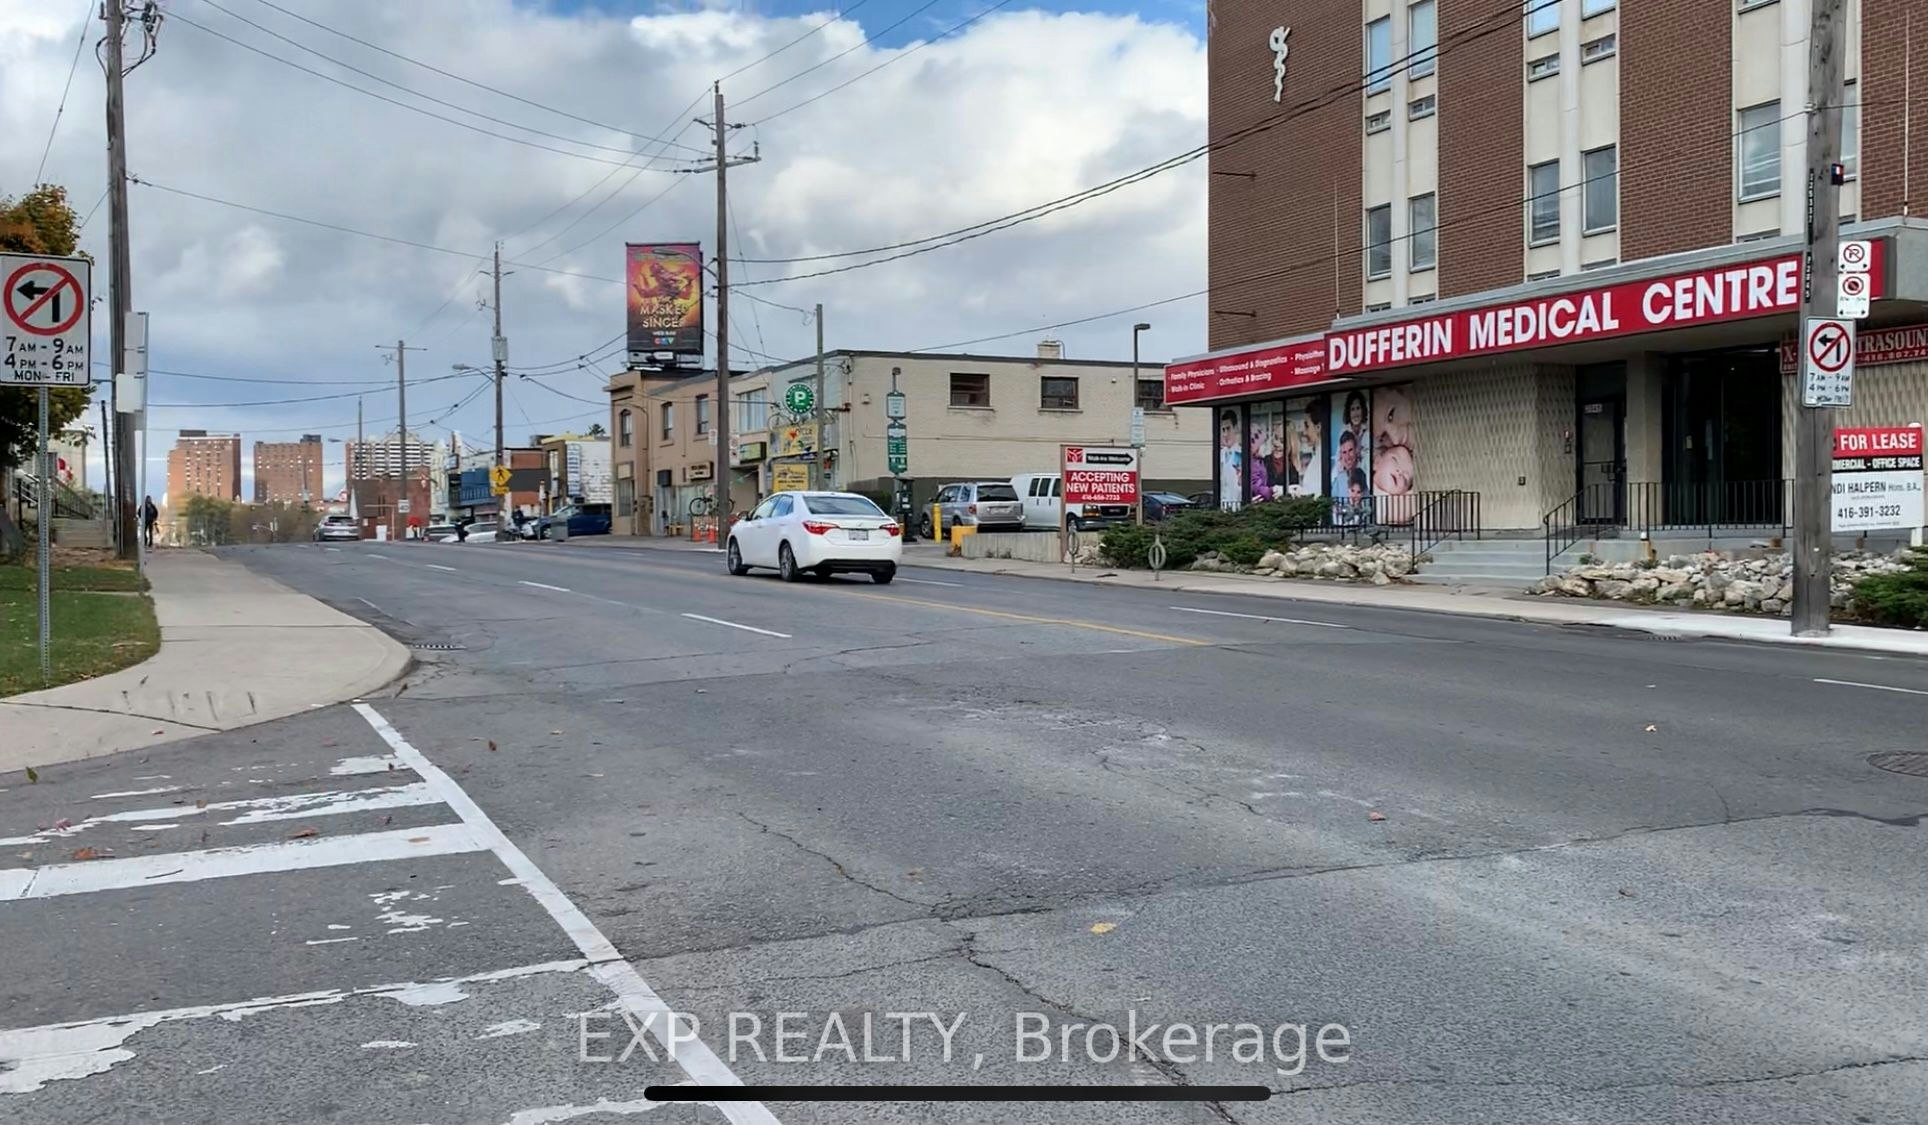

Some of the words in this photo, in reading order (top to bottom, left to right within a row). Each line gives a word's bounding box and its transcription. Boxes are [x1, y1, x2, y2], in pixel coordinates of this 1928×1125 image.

[1329, 318, 1452, 370] DUFFERIN
[1469, 291, 1619, 350] MEDICAL
[1642, 260, 1797, 324] CENTRE
[6, 336, 16, 351] 7
[19, 343, 37, 352] AM
[53, 338, 64, 353] 9
[66, 345, 83, 354] AM
[4, 353, 16, 369] 4
[20, 359, 37, 369] PM
[52, 354, 63, 370] 6
[67, 361, 83, 370] PM
[14, 370, 42, 380] MON
[56, 371, 74, 381] FRI
[1840, 434, 1868, 451] FOR
[1871, 433, 1917, 450] LEASE
[1872, 457, 1897, 469] OFFICE
[1897, 456, 1920, 468] SPACE
[1070, 472, 1129, 482] ACCEPTING
[1066, 482, 1089, 493] NEW
[1091, 483, 1136, 494] PATIENTS
[1848, 481, 1887, 494] HALPERN
[1838, 504, 1900, 519] 416-391-3232
